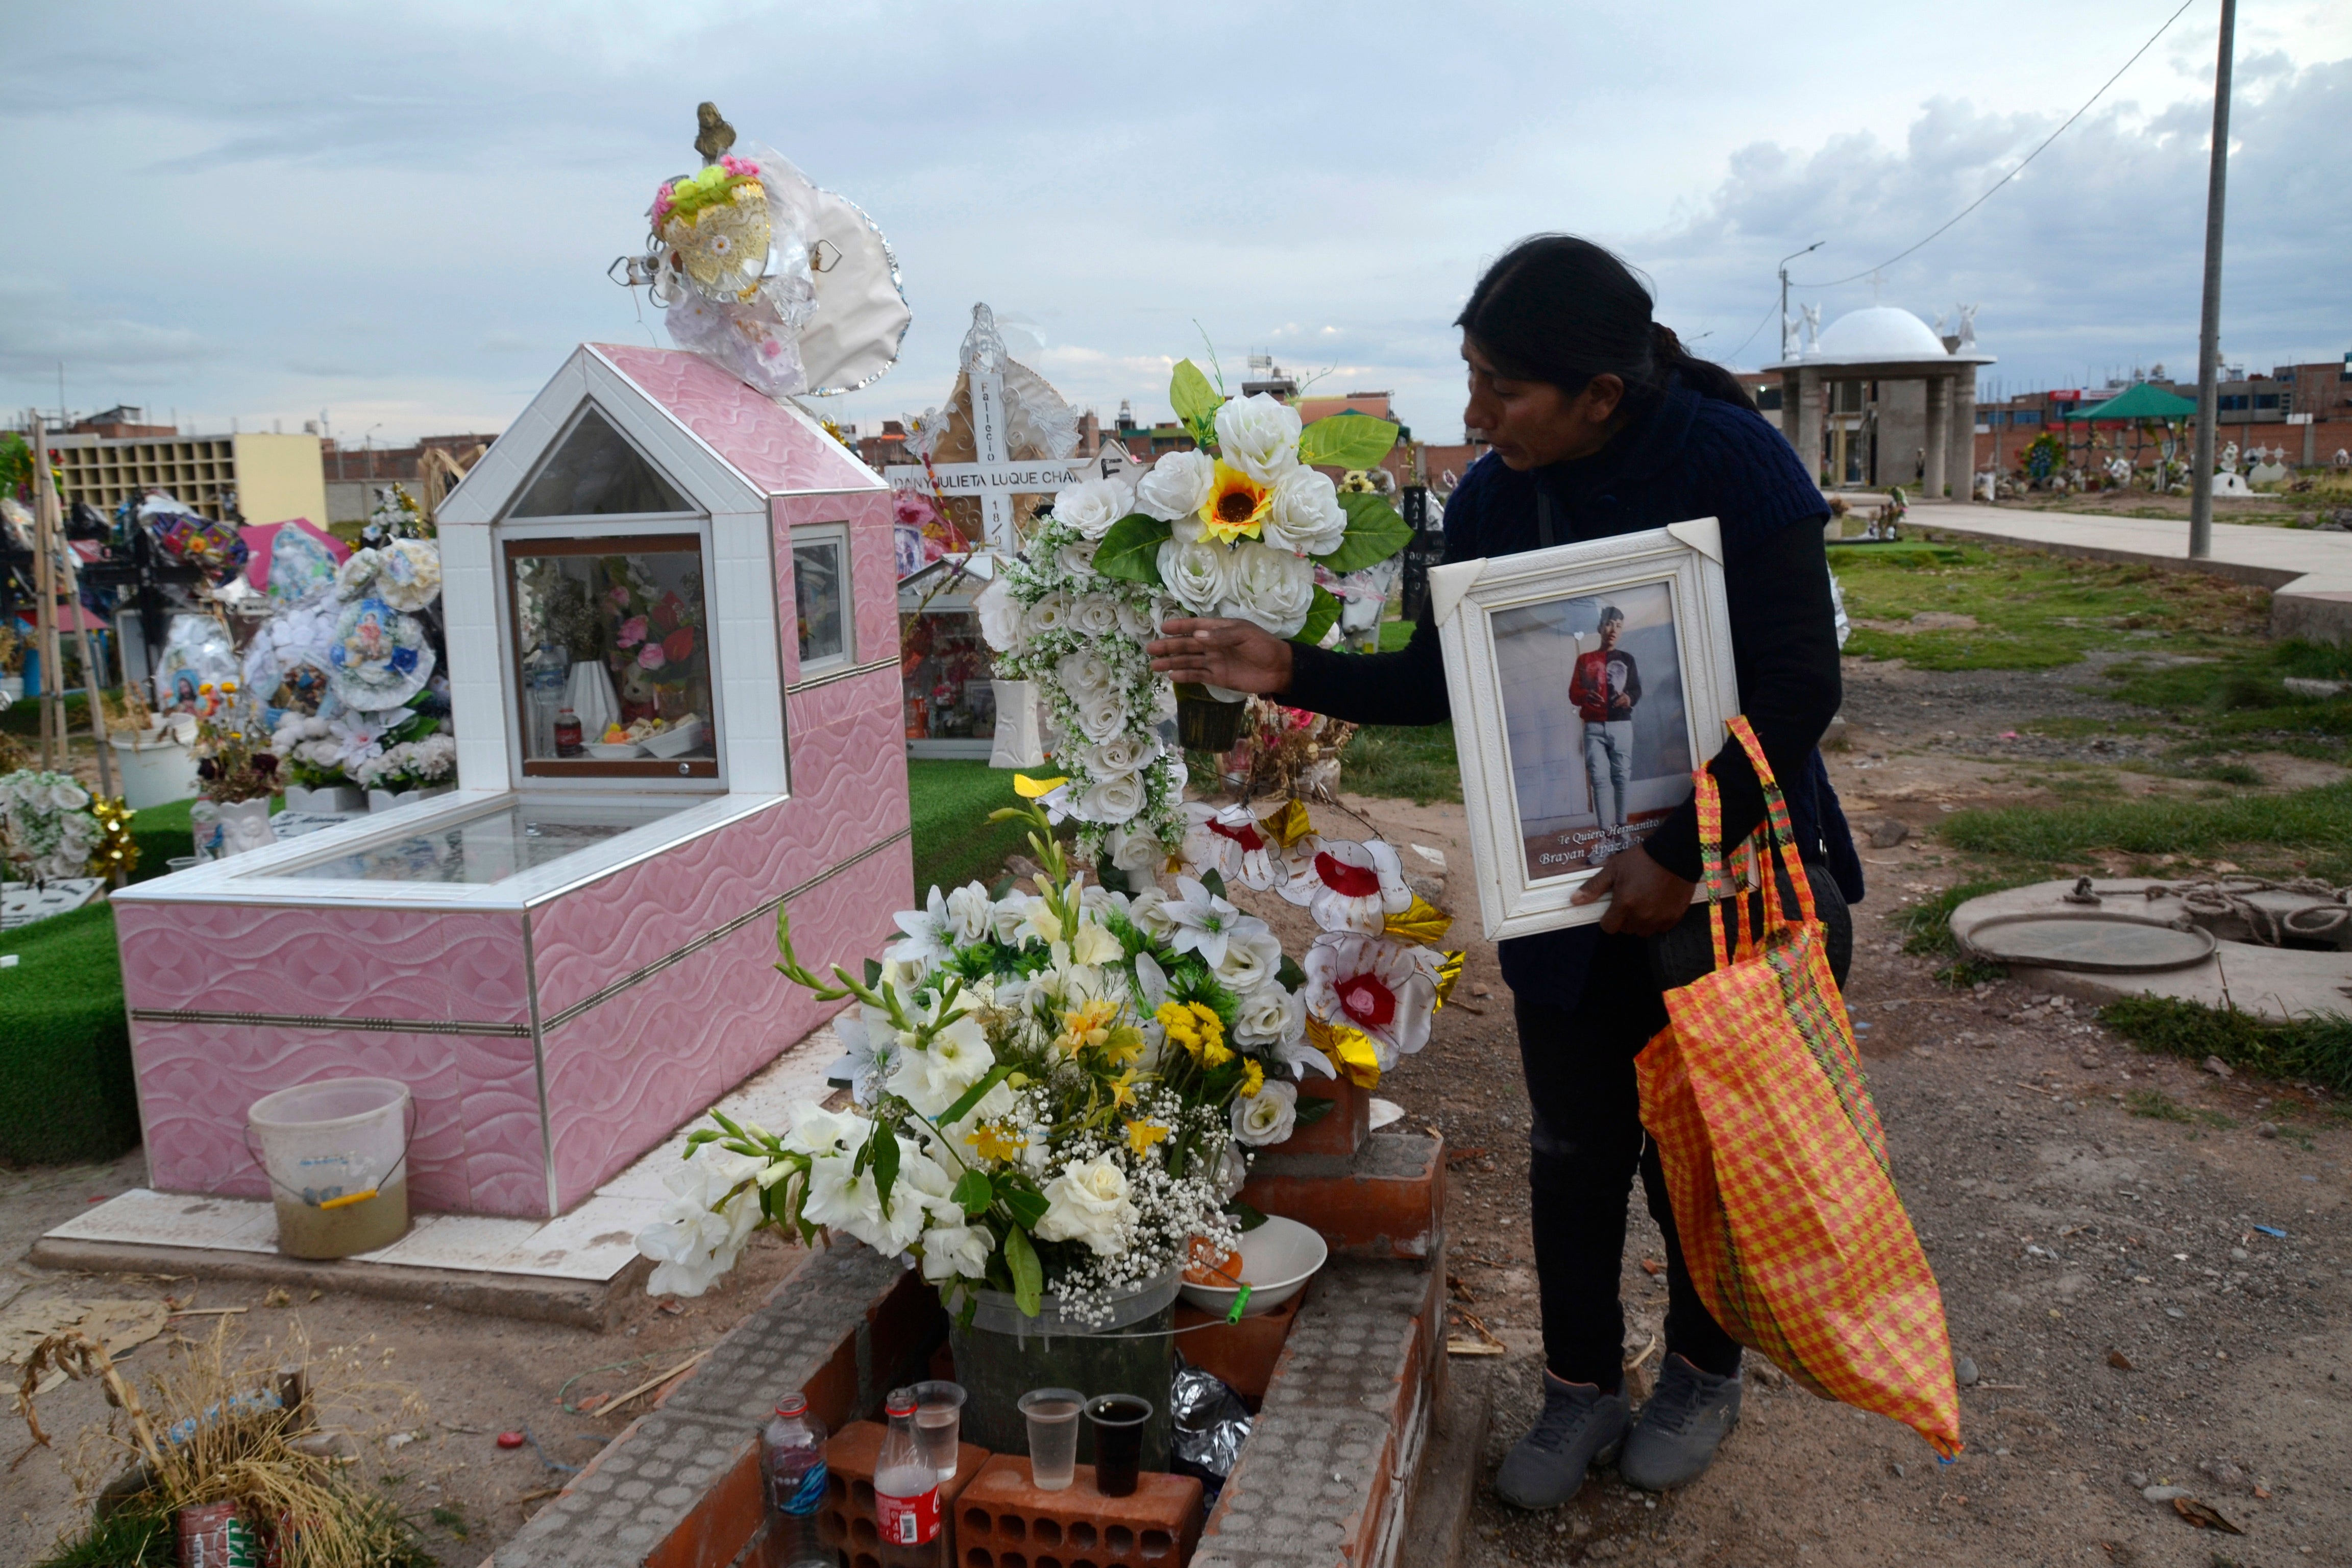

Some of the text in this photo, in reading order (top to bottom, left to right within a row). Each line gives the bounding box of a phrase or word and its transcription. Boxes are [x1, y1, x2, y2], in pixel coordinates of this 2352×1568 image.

[981, 382, 995, 461] Fallecio
[936, 475, 987, 487] JULIETA
[992, 472, 1038, 485] LUQUE
[1042, 471, 1076, 483] CHA
[1558, 818, 1659, 845] Te Quiero Hermanito
[1539, 841, 1629, 865] Brayan Apaza
